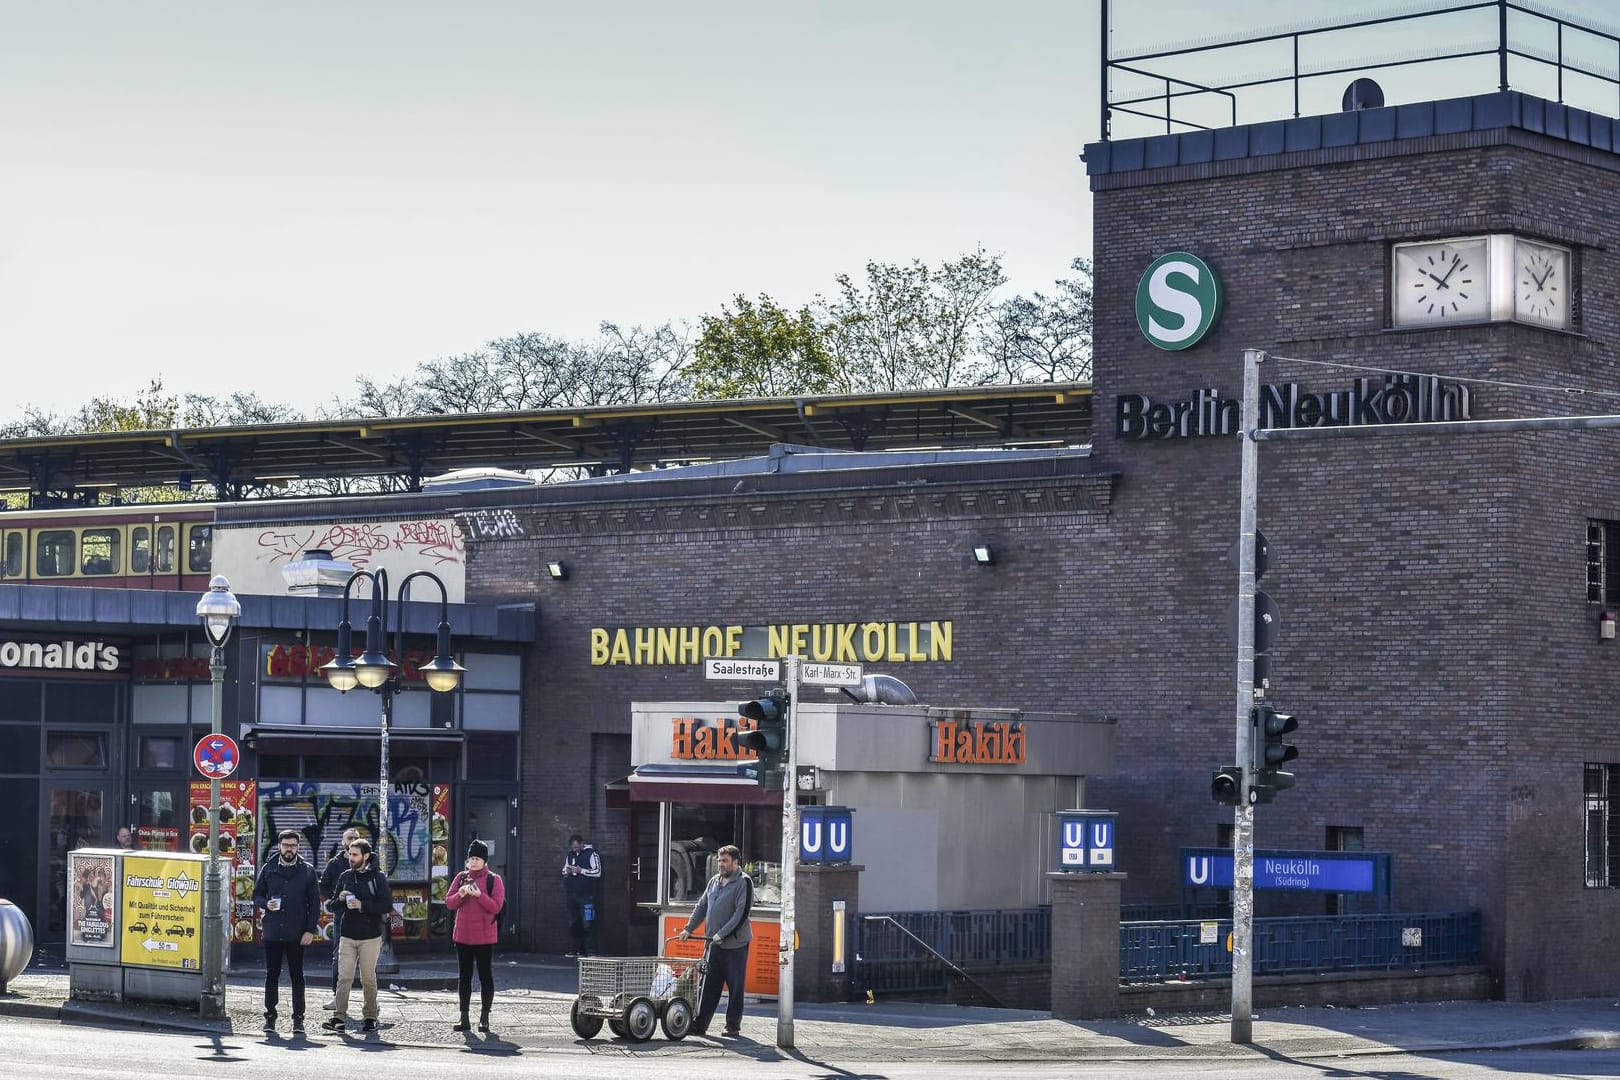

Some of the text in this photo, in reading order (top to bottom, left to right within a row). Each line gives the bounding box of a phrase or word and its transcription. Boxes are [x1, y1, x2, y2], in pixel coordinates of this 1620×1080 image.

[1149, 261, 1202, 342] S
[1115, 373, 1473, 440] Berlin Neukölln
[591, 621, 952, 665] BAHNHOF NEUKÖLLN
[713, 662, 774, 677] Saalestraße
[804, 665, 856, 680] Karl-Marx-Str.
[936, 720, 1026, 764] Hakiki
[803, 822, 821, 852] U
[830, 822, 846, 852] U
[1066, 823, 1081, 848] U
[1095, 823, 1107, 848] U
[1190, 857, 1208, 885] U
[1265, 859, 1319, 876] Neukölln
[127, 875, 164, 889] Fahrschule
[1275, 876, 1310, 888] (Südring)
[129, 901, 137, 909] Mit
[138, 902, 157, 910] Qualität
[170, 904, 196, 913] Sicherheit
[151, 912, 185, 922] Führerschein
